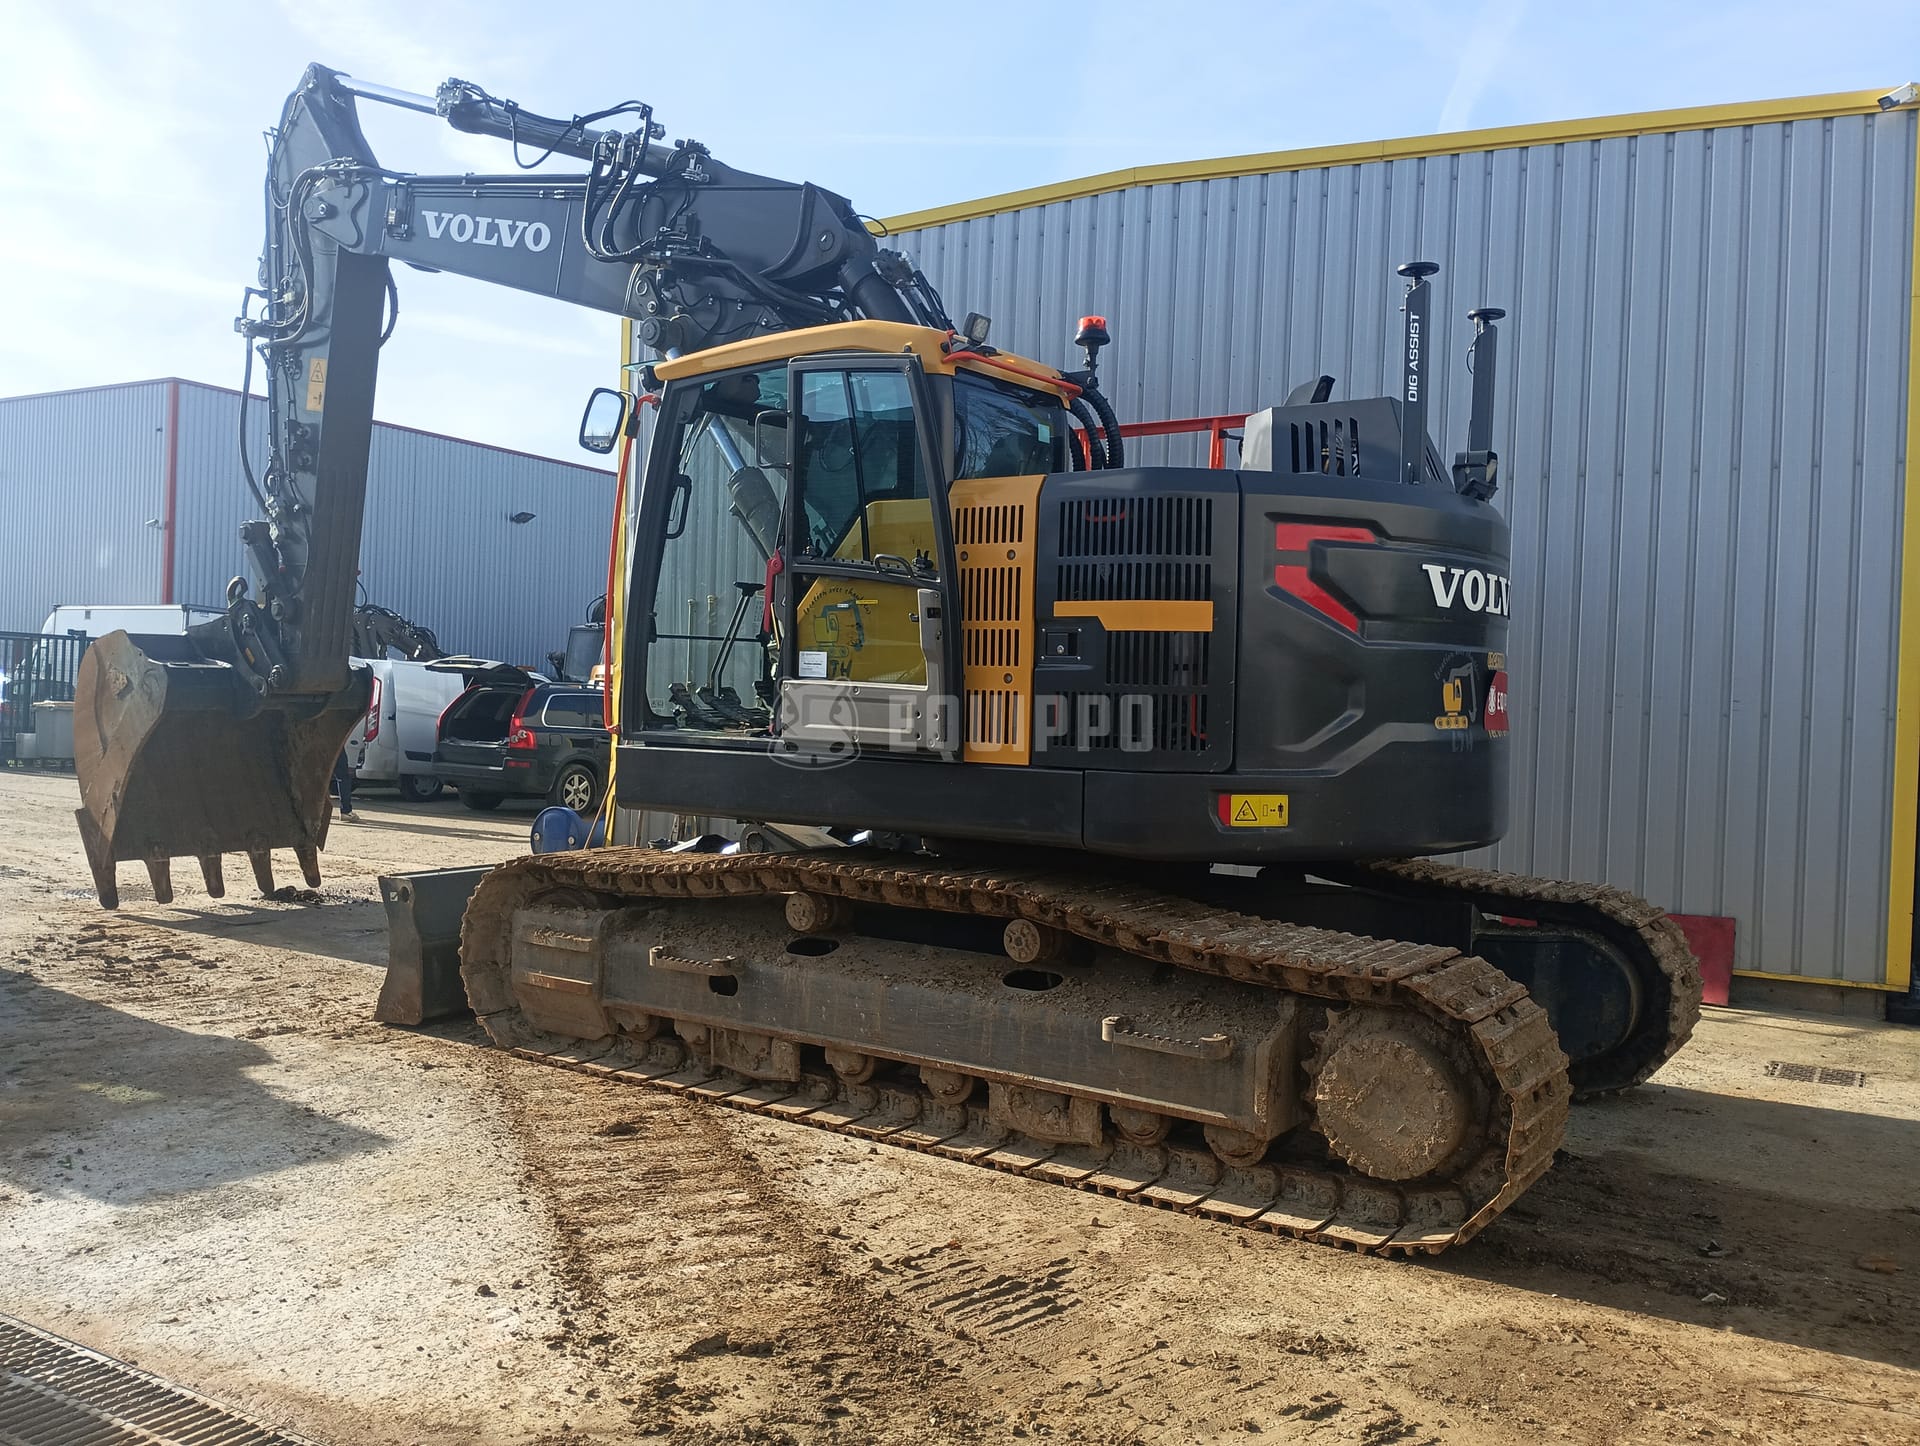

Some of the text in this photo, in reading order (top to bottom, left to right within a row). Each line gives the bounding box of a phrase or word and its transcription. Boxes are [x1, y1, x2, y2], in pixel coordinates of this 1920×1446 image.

[421, 210, 551, 252] VOLVO
[1408, 311, 1420, 402] DIG ASSIST
[1421, 563, 1511, 616] VOLV
